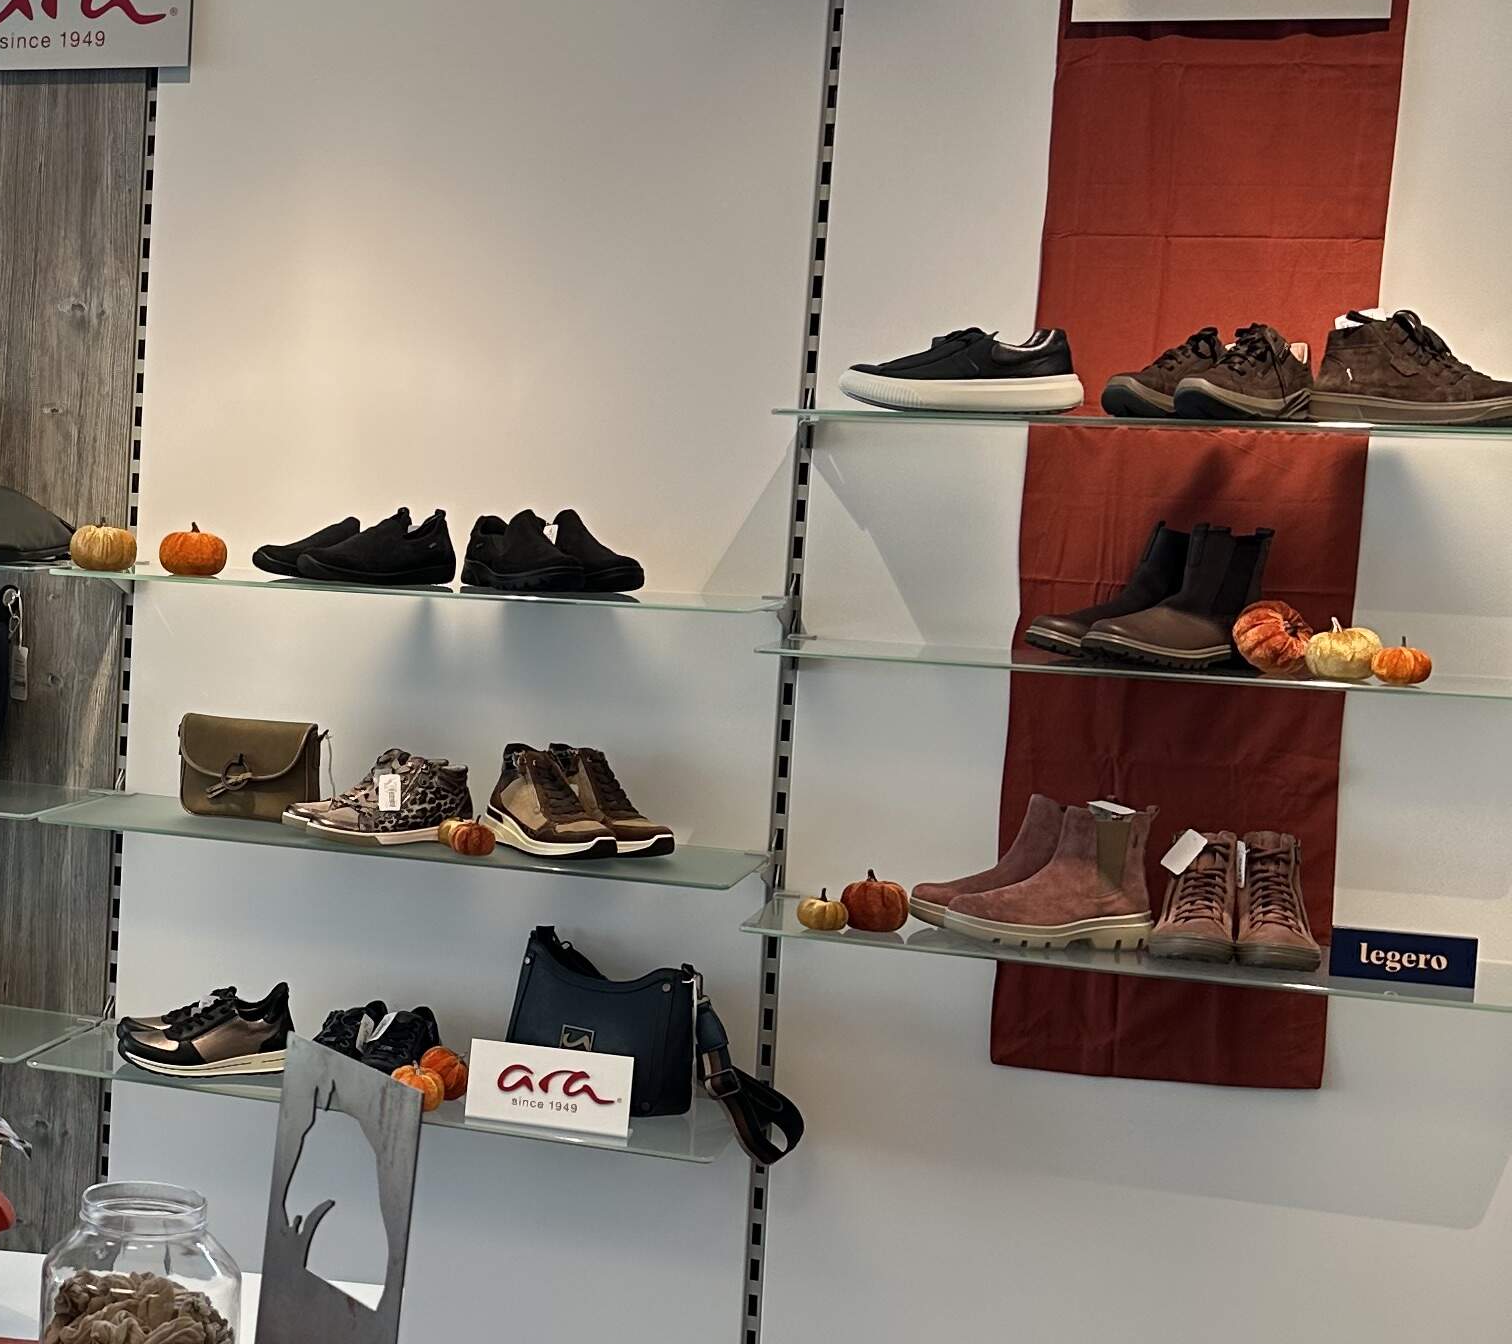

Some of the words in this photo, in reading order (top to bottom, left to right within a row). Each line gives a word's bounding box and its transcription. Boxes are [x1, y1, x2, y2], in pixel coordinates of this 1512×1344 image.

[0, 33, 51, 49] since
[59, 30, 106, 48] 1949
[1359, 942, 1448, 973] legero
[497, 1063, 615, 1106] ara
[511, 1096, 544, 1109] since
[549, 1101, 578, 1114] 1949
